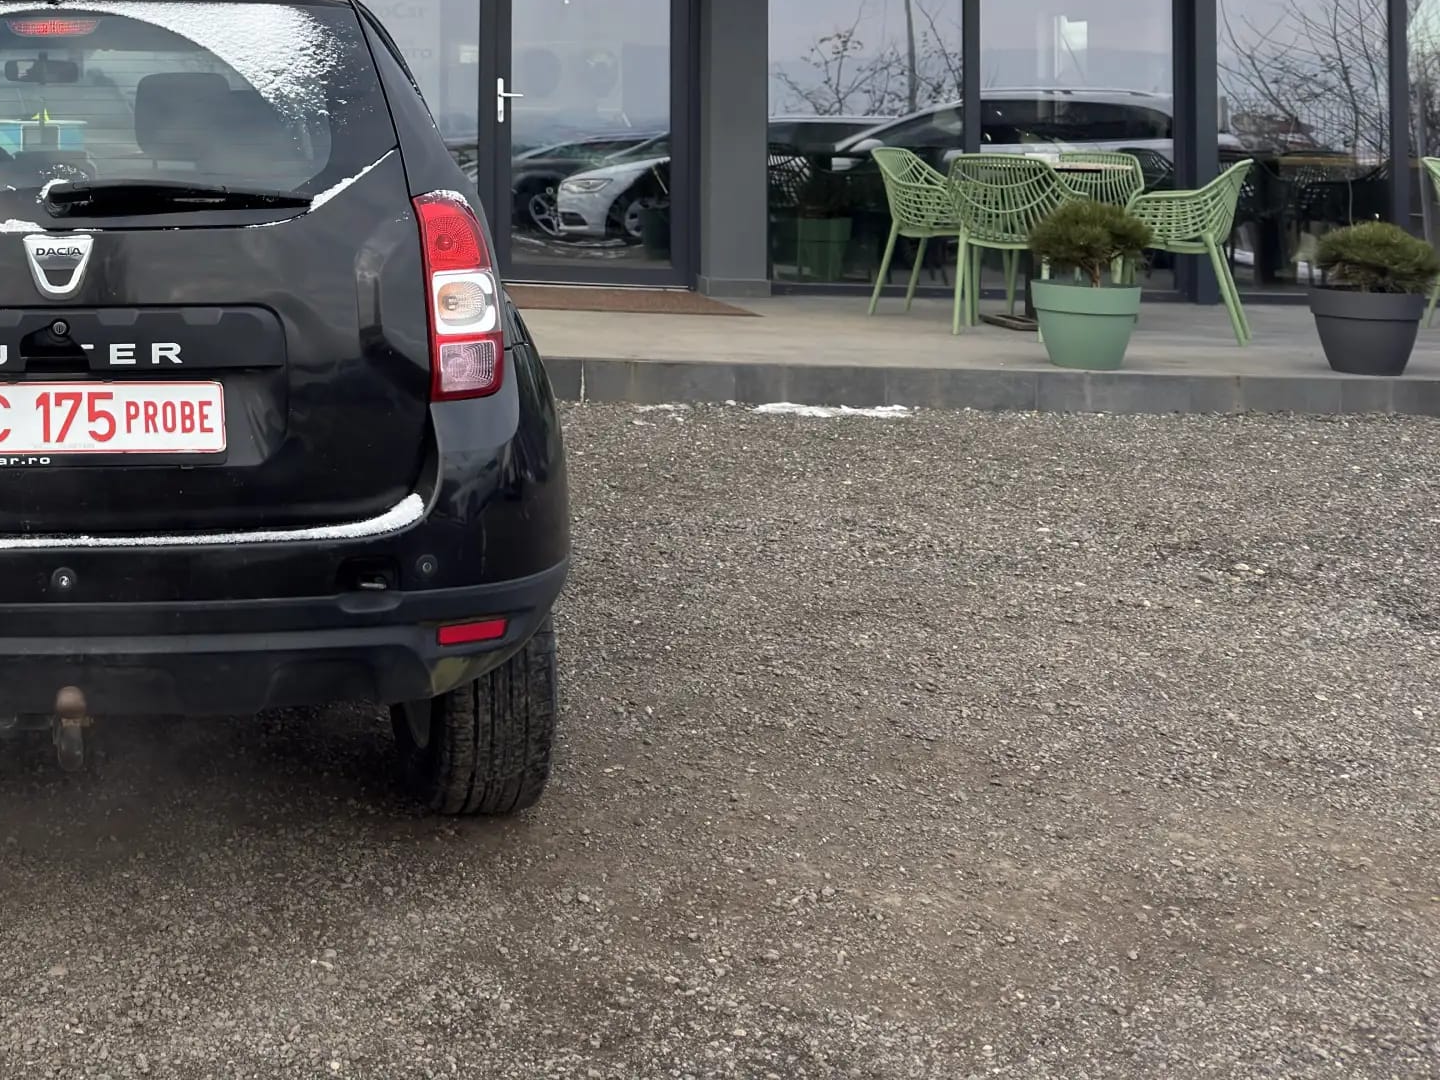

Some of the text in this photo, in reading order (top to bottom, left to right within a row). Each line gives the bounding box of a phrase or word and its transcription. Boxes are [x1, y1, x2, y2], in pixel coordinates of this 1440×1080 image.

[36, 247, 82, 256] DACIA
[35, 392, 117, 443] 175
[125, 400, 214, 434] PROBE
